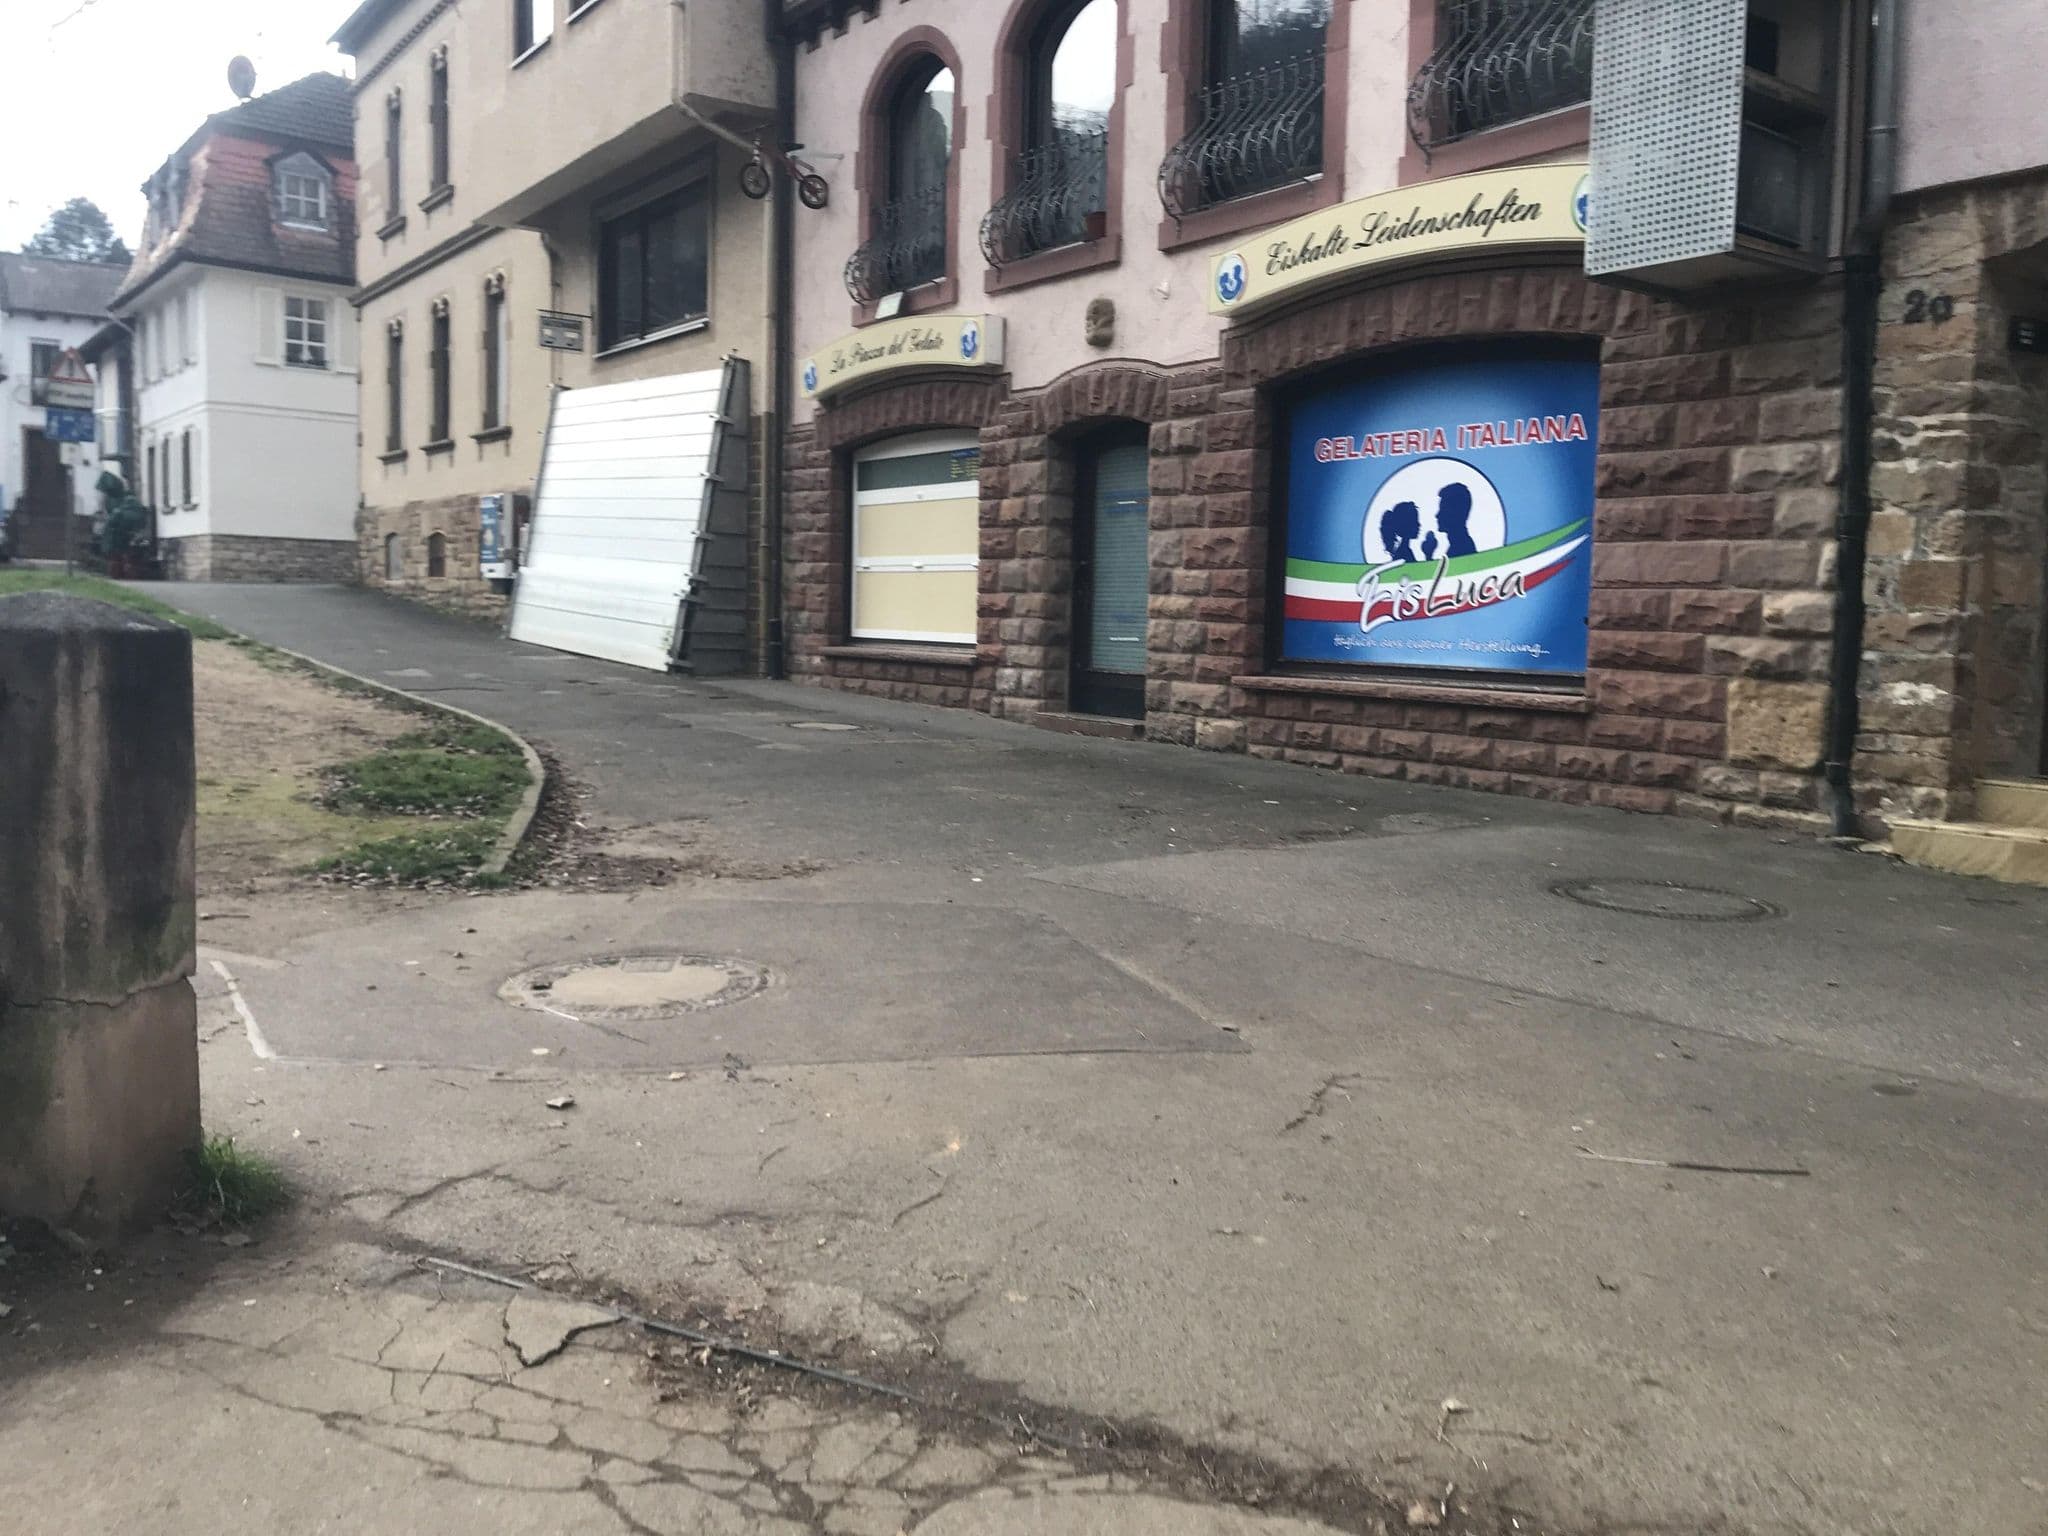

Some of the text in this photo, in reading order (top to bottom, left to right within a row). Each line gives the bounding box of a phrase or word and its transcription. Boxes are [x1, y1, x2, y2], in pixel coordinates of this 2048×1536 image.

[1266, 187, 1543, 276] Eiskalte Leidenschaften
[1314, 413, 1588, 463] GELATERIA ITALIANA
